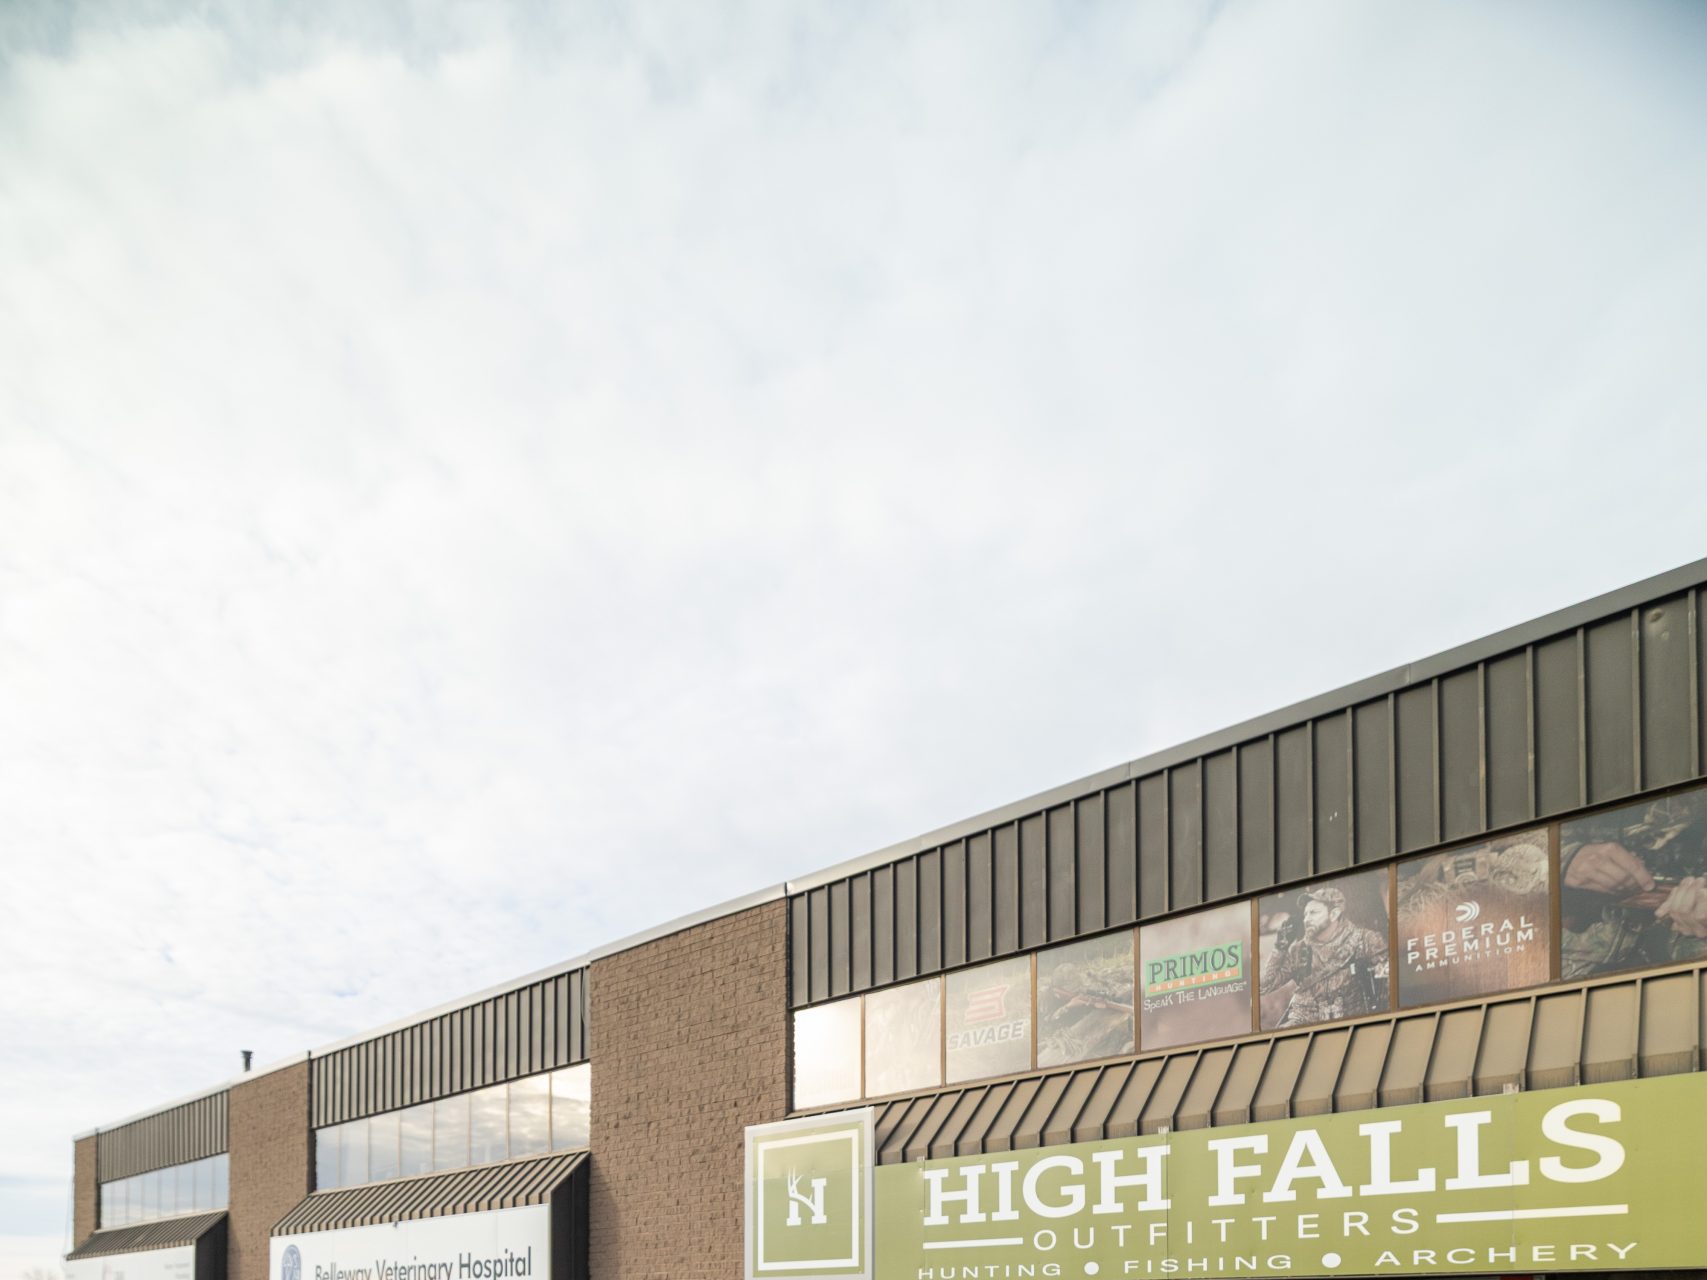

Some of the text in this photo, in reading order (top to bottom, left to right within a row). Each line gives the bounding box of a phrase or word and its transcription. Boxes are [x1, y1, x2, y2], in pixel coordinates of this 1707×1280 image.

[1407, 915, 1534, 951] FEDERAL
[1407, 928, 1534, 964] PREMIUM
[1148, 944, 1239, 985] PRIMOS
[1415, 944, 1525, 972] AMMUNITION
[1155, 969, 1231, 992] HUNTING
[947, 1021, 1024, 1051] SAVAGE
[923, 1098, 1626, 1226] HIGH FALLS
[1033, 1207, 1420, 1251] OUTFITTERS
[917, 1242, 1639, 1280] HUNTING FISHING ARCHERY
